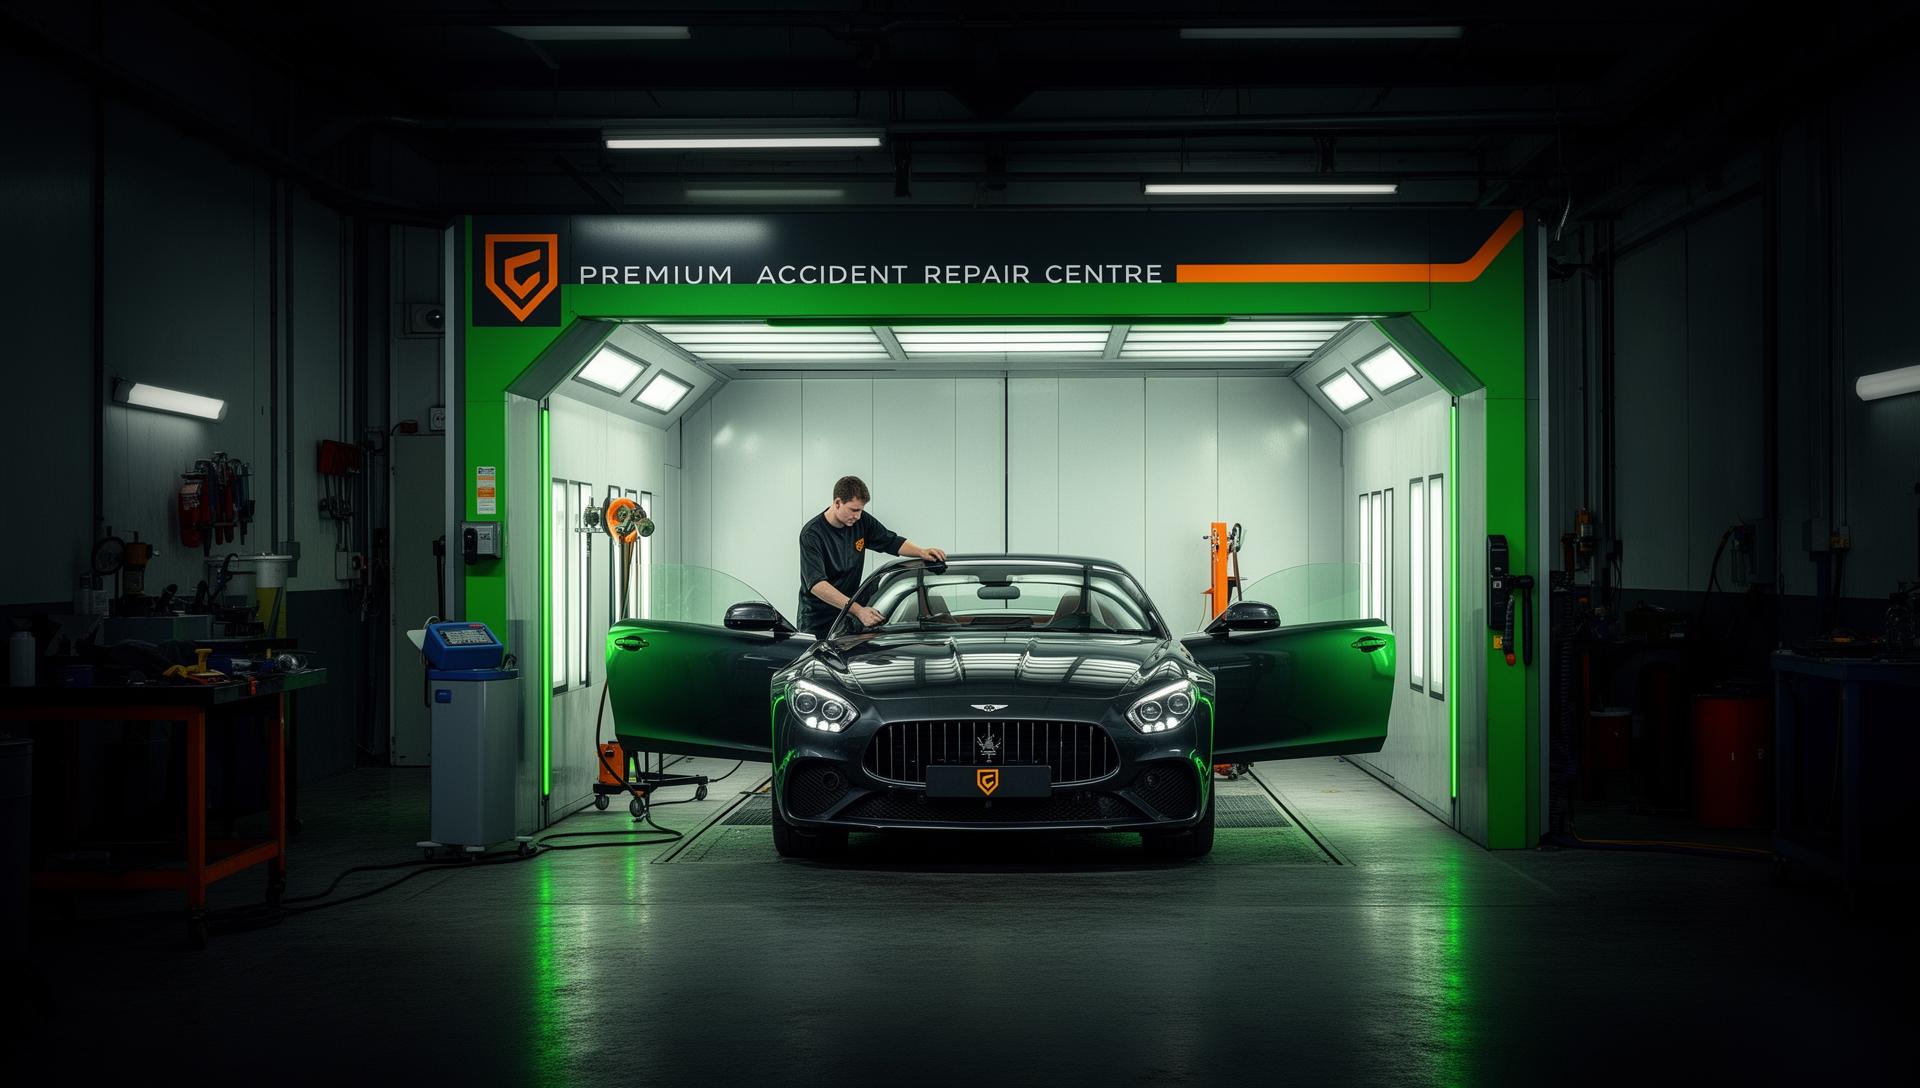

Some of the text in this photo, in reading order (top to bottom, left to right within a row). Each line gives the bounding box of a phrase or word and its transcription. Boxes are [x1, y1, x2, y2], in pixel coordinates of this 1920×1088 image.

[580, 264, 1162, 285] PREMIUM ACCIDENT REPAIR CENTRE
